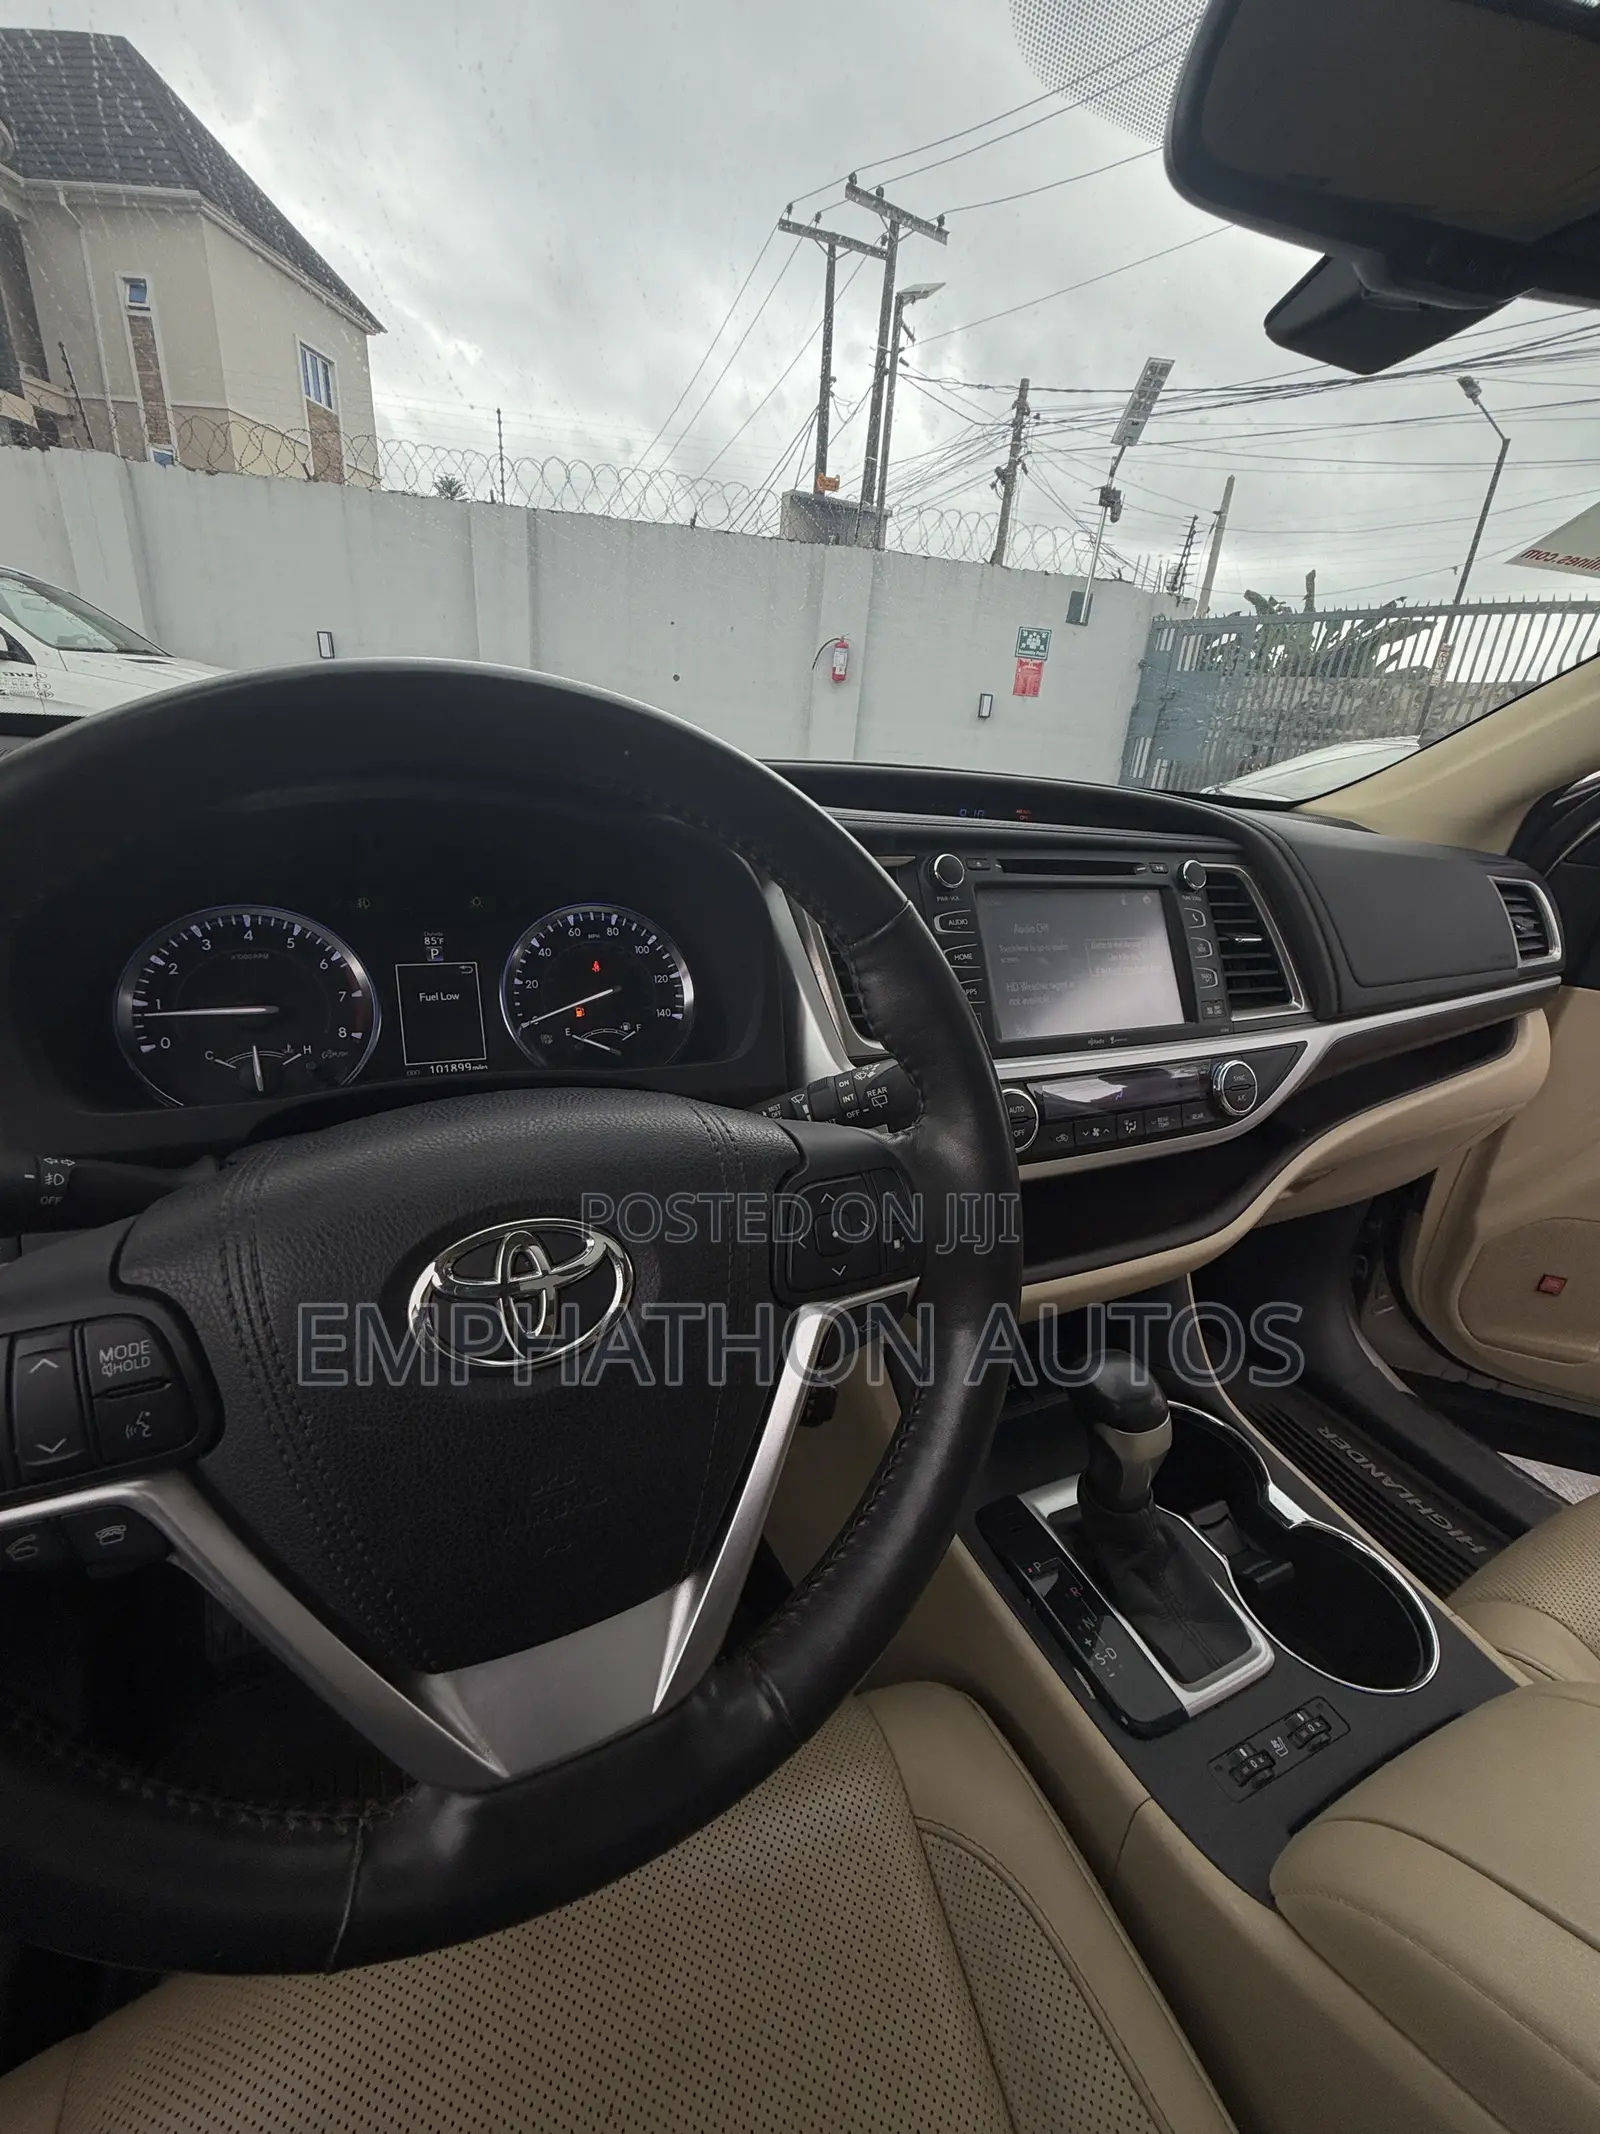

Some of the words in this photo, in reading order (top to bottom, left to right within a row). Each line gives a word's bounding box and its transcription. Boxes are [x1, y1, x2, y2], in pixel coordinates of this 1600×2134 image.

[948, 918, 968, 926] AUDIO
[243, 930, 254, 941] 4
[568, 927, 581, 937] 60
[606, 927, 619, 936] 80
[202, 939, 212, 950] 3
[286, 938, 295, 949] 5
[430, 948, 440, 960] P
[538, 947, 551, 957] 40
[635, 945, 650, 954] 100
[954, 952, 973, 961] HOME
[168, 964, 178, 975] 2
[319, 959, 328, 970] 6
[526, 979, 539, 989] 20
[654, 974, 668, 984] 120
[338, 991, 347, 1002] 7
[419, 991, 438, 1002] Fuel
[440, 991, 460, 1002] Low
[156, 999, 161, 1010] 1
[656, 1008, 671, 1018] 140
[338, 1027, 347, 1038] 8
[565, 1028, 571, 1036] E
[636, 1024, 641, 1032] F
[160, 1037, 171, 1049] 0
[303, 1045, 312, 1054] H
[205, 1051, 214, 1061] C
[429, 1062, 471, 1074] 101899
[842, 1093, 855, 1103] INT
[867, 1087, 887, 1098] REAR
[768, 1103, 781, 1112] MIST
[1009, 1105, 1025, 1114] AUTO
[847, 1109, 860, 1119] OFF
[1013, 1129, 1025, 1138] OFF
[100, 1340, 150, 1363] MODE
[113, 1356, 150, 1374] HOLD
[1317, 1426, 1487, 1554] HIGHLANDER
[1033, 1561, 1042, 1572] P
[1070, 1586, 1082, 1597] R
[1082, 1618, 1095, 1630] N
